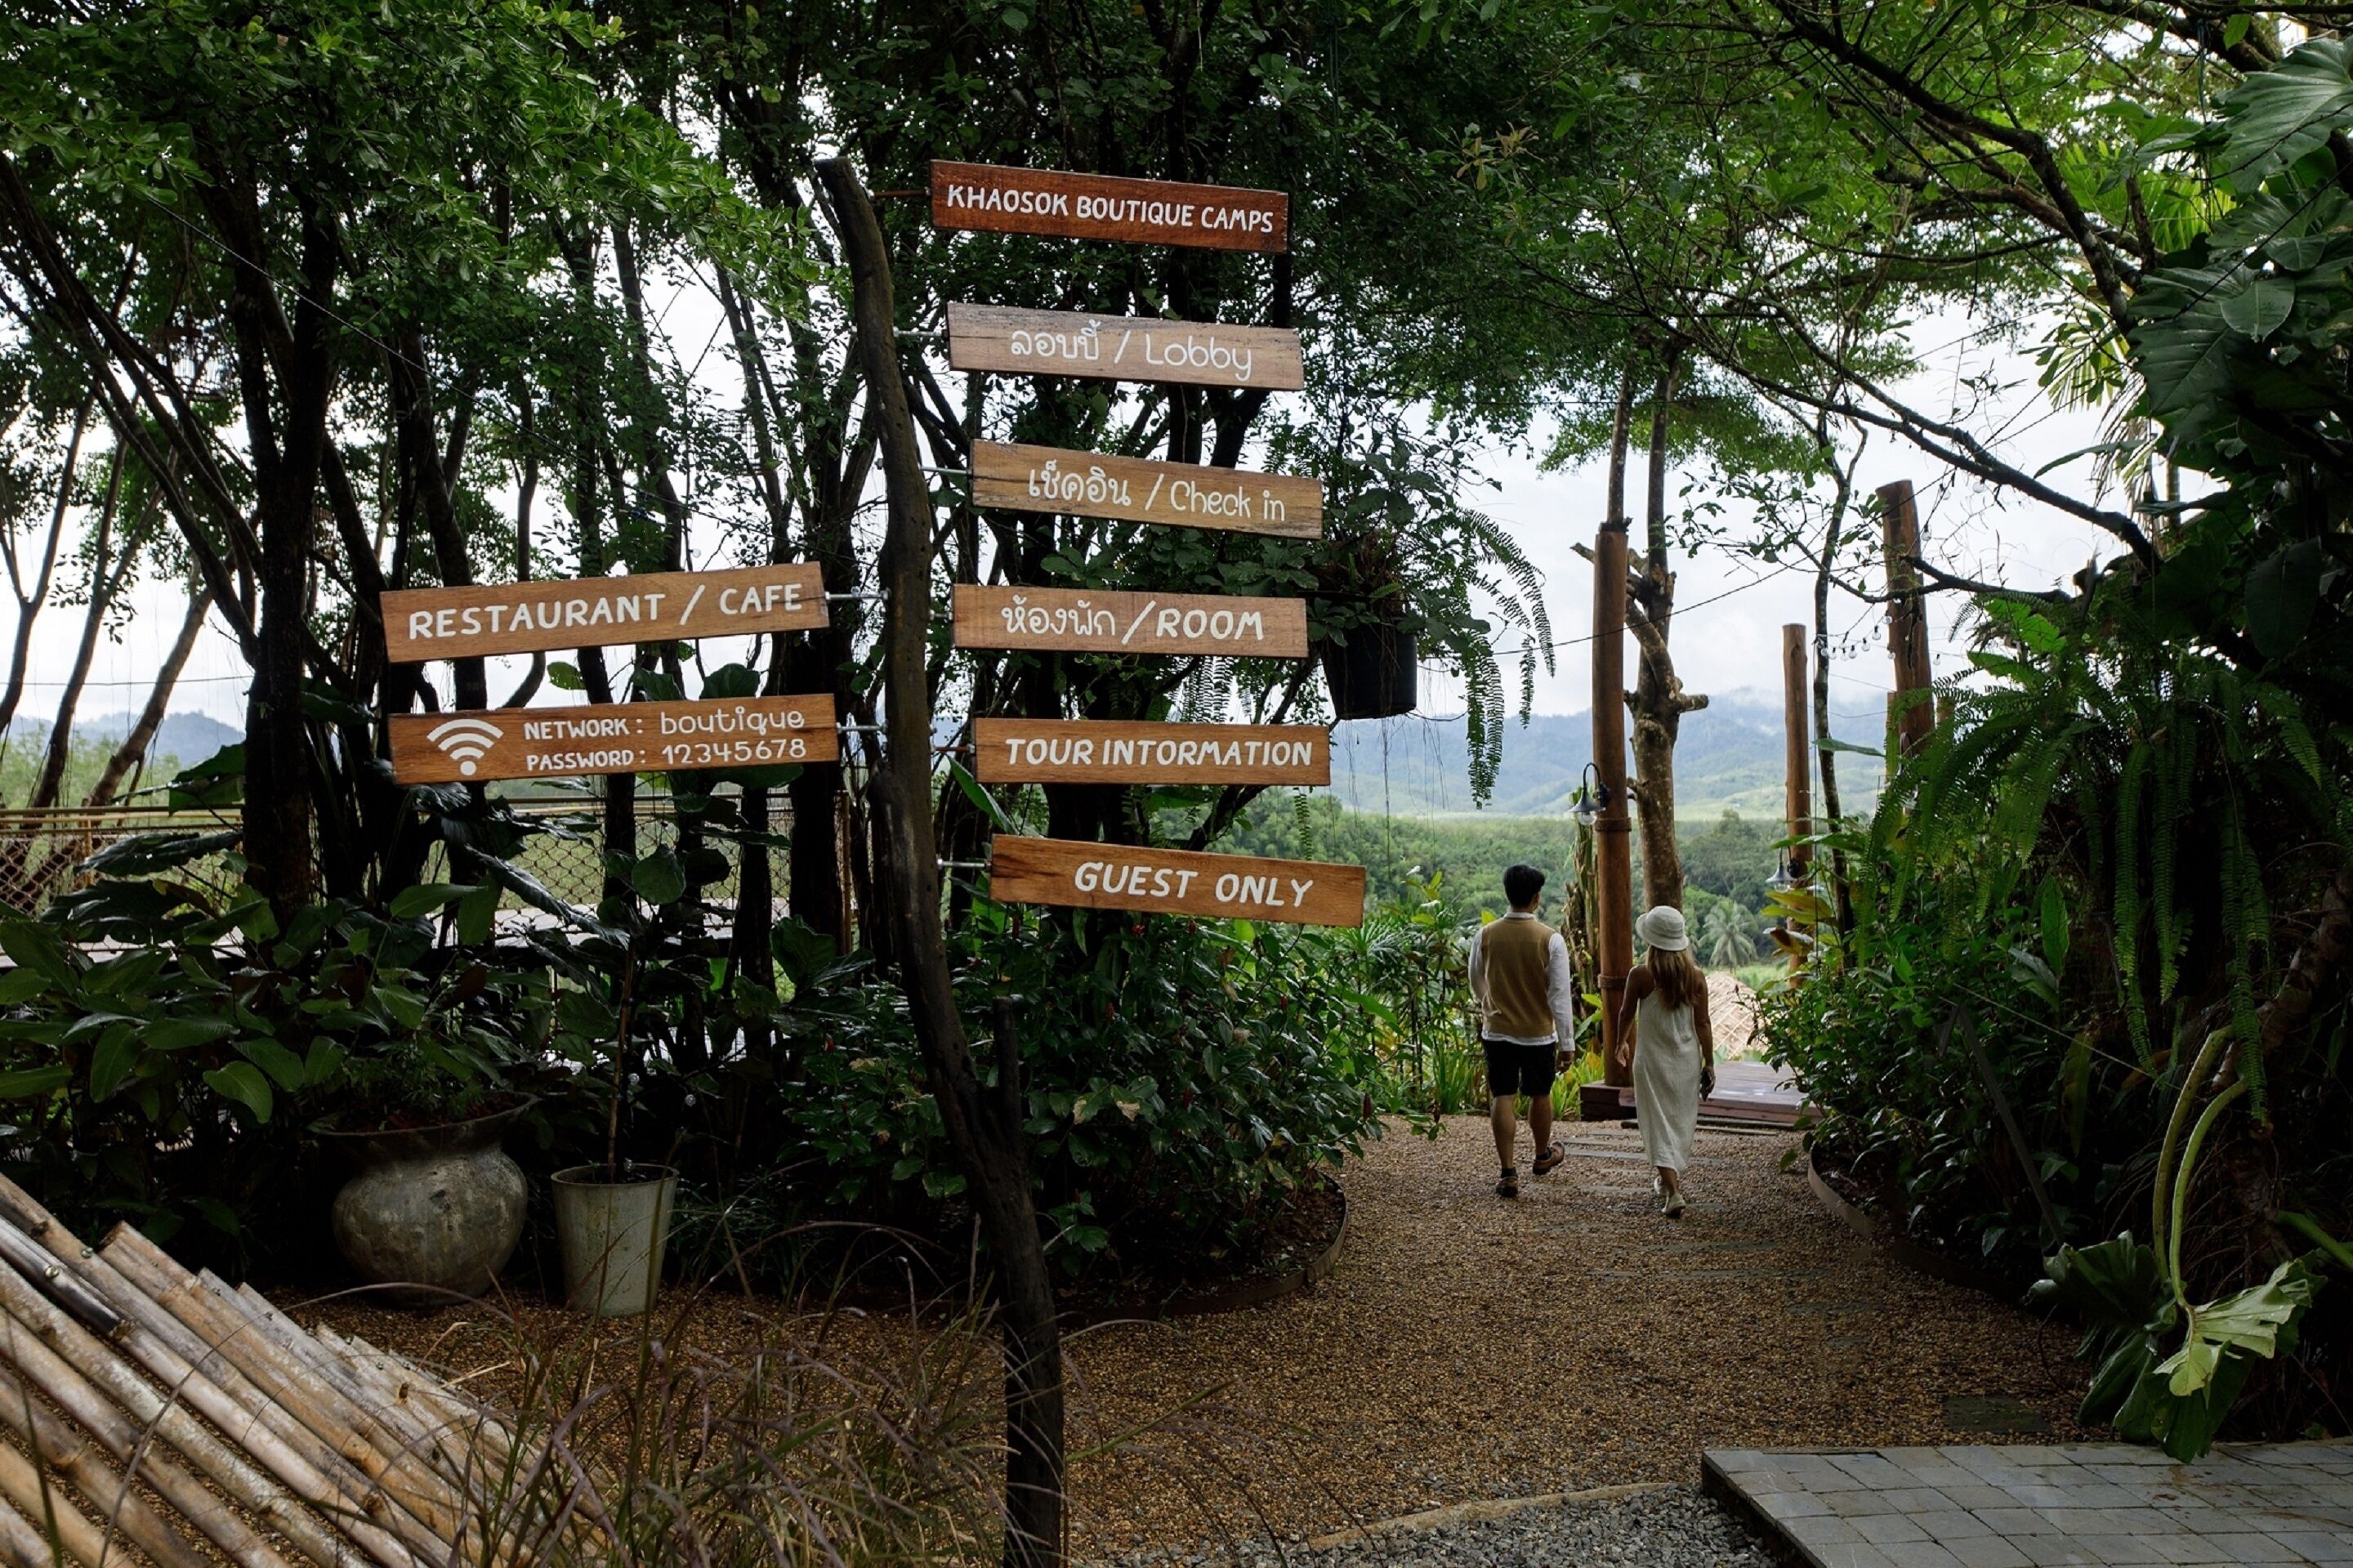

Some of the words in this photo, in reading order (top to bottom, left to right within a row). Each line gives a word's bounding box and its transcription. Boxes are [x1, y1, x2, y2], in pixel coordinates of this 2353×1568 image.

[947, 184, 1068, 216] KHAOSOK
[1077, 194, 1194, 227] BOUTIQUE
[1201, 207, 1274, 233] CAMPS
[1011, 319, 1101, 360] ลอบบี้
[1145, 333, 1252, 382] Lobby
[1029, 459, 1131, 507] เช็คอิน
[1263, 490, 1285, 521] in
[409, 593, 666, 640] RESTAURANT
[720, 583, 803, 616] CAFE
[1001, 595, 1116, 637] ห้องพัก
[661, 706, 805, 735] boutique
[661, 739, 807, 765] 12345678
[1005, 739, 1093, 765] TOUR
[1102, 739, 1312, 766] INTORMATION
[1074, 861, 1198, 898] GUEST
[1216, 873, 1313, 907] ONLY
